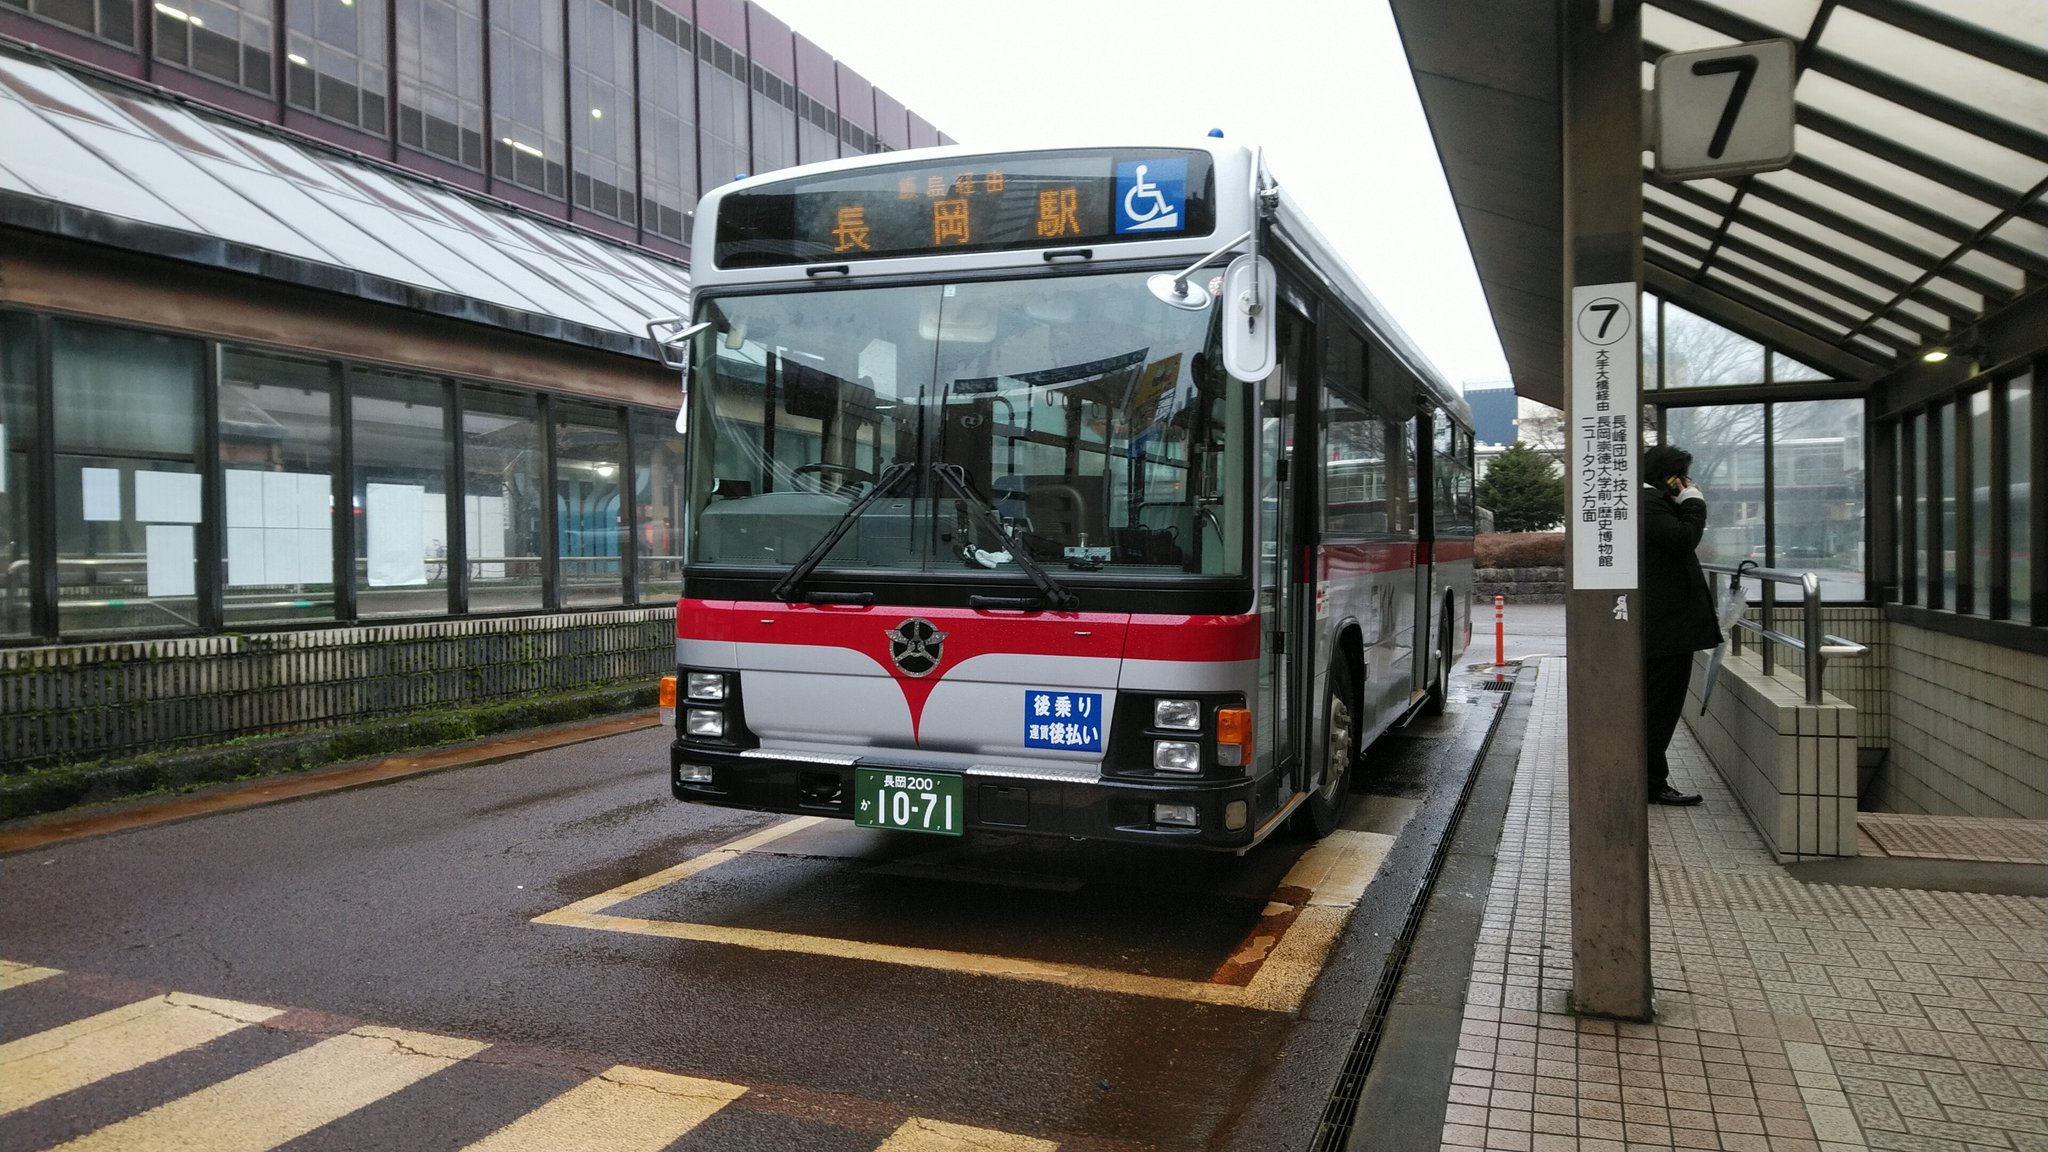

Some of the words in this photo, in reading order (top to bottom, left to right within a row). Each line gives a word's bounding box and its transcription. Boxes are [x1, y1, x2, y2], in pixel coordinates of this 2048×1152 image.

[1691, 54, 1760, 159] 7
[899, 171, 1004, 200] 島経由
[832, 188, 1081, 252] 長岡駅
[1589, 303, 1620, 338] 7
[1595, 348, 1611, 412] 大手大橋経由
[1582, 416, 1597, 523] ニュータウン方面
[1612, 414, 1629, 521] 長峰団地・技大前
[1033, 694, 1092, 718] 後乗り
[1029, 722, 1099, 746] 運賃後払い
[860, 799, 871, 811] か
[878, 789, 952, 830] 10-71
